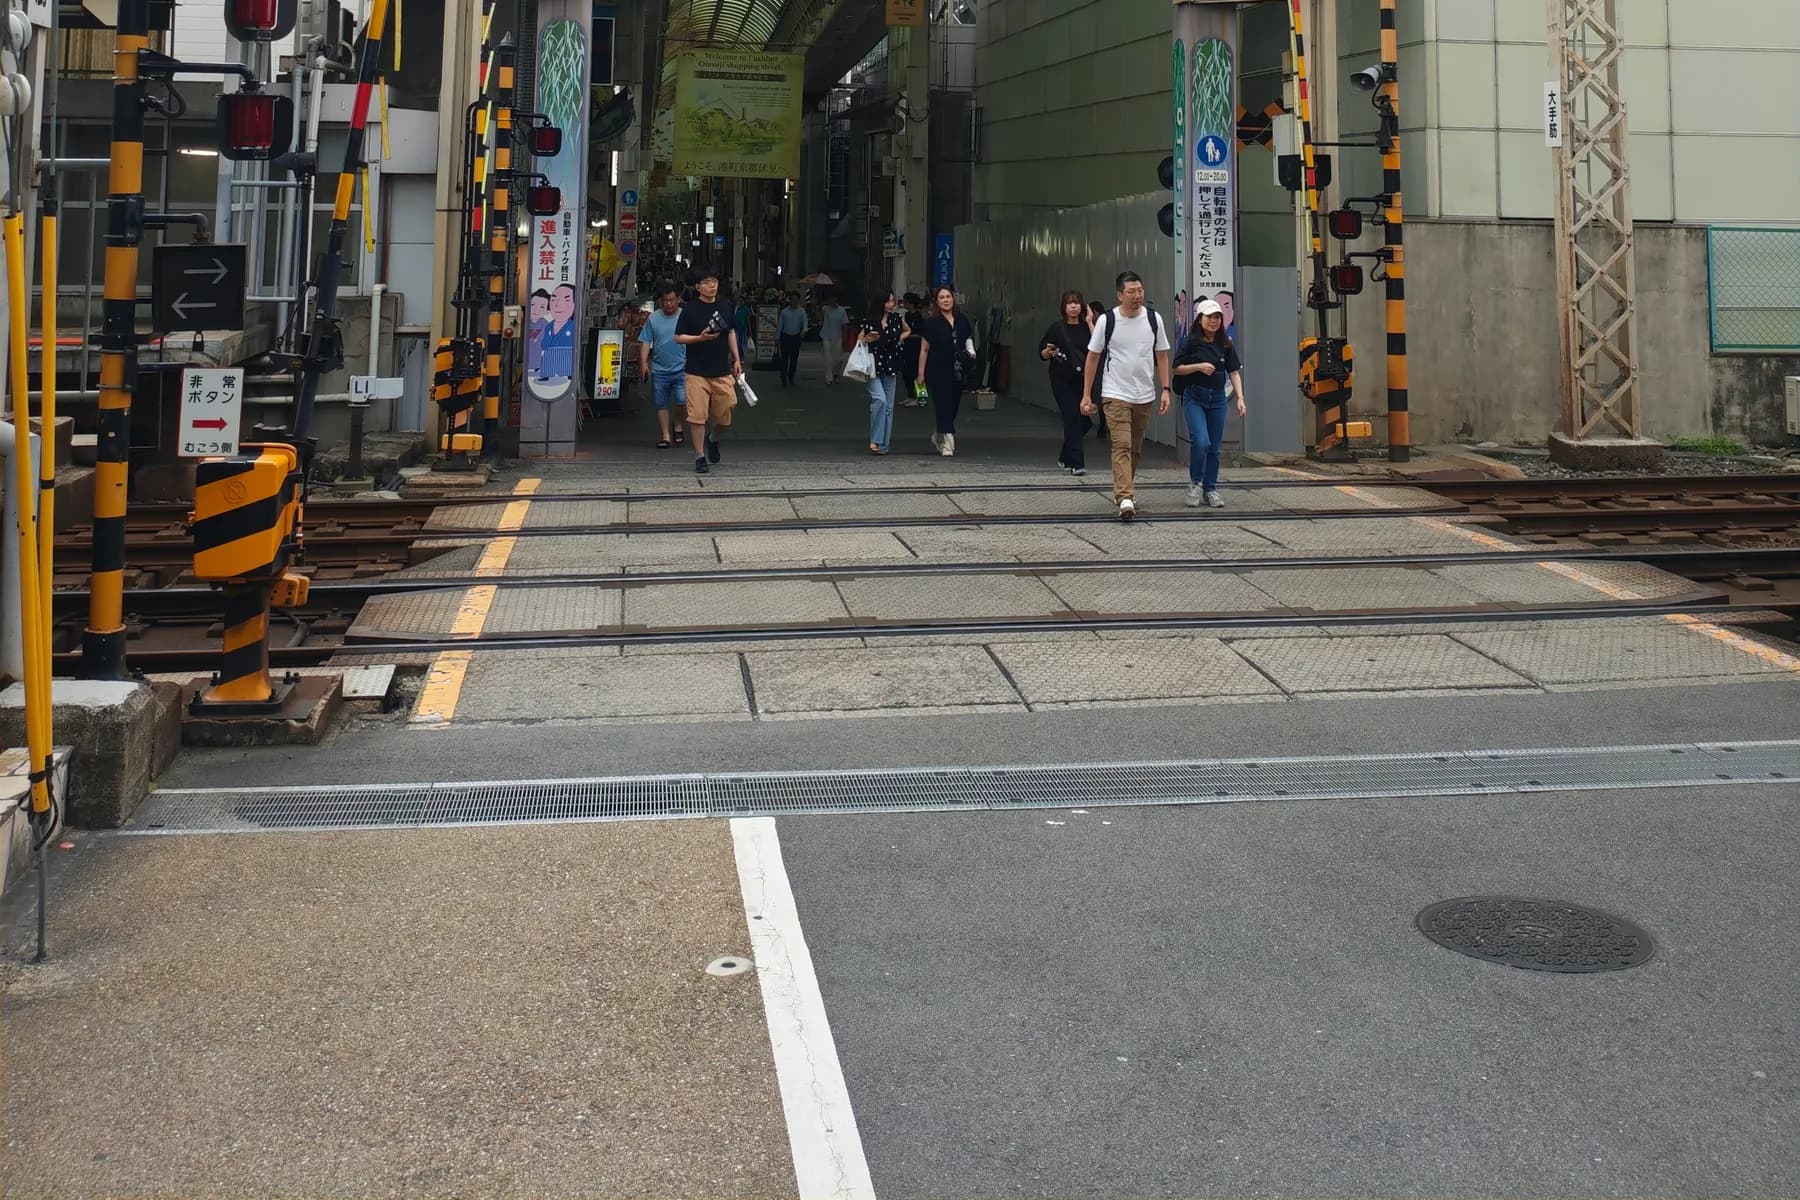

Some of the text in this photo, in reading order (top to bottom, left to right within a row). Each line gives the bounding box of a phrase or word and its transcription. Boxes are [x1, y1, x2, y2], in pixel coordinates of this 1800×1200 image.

[1548, 90, 1557, 138] 大手筋
[1199, 186, 1212, 277] 押して通行してください
[1214, 186, 1227, 246] 自転車の方は
[538, 219, 556, 280] 進入禁止
[188, 390, 235, 404] ボタン
[190, 375, 236, 389] 非常
[184, 442, 233, 453] むこう側
